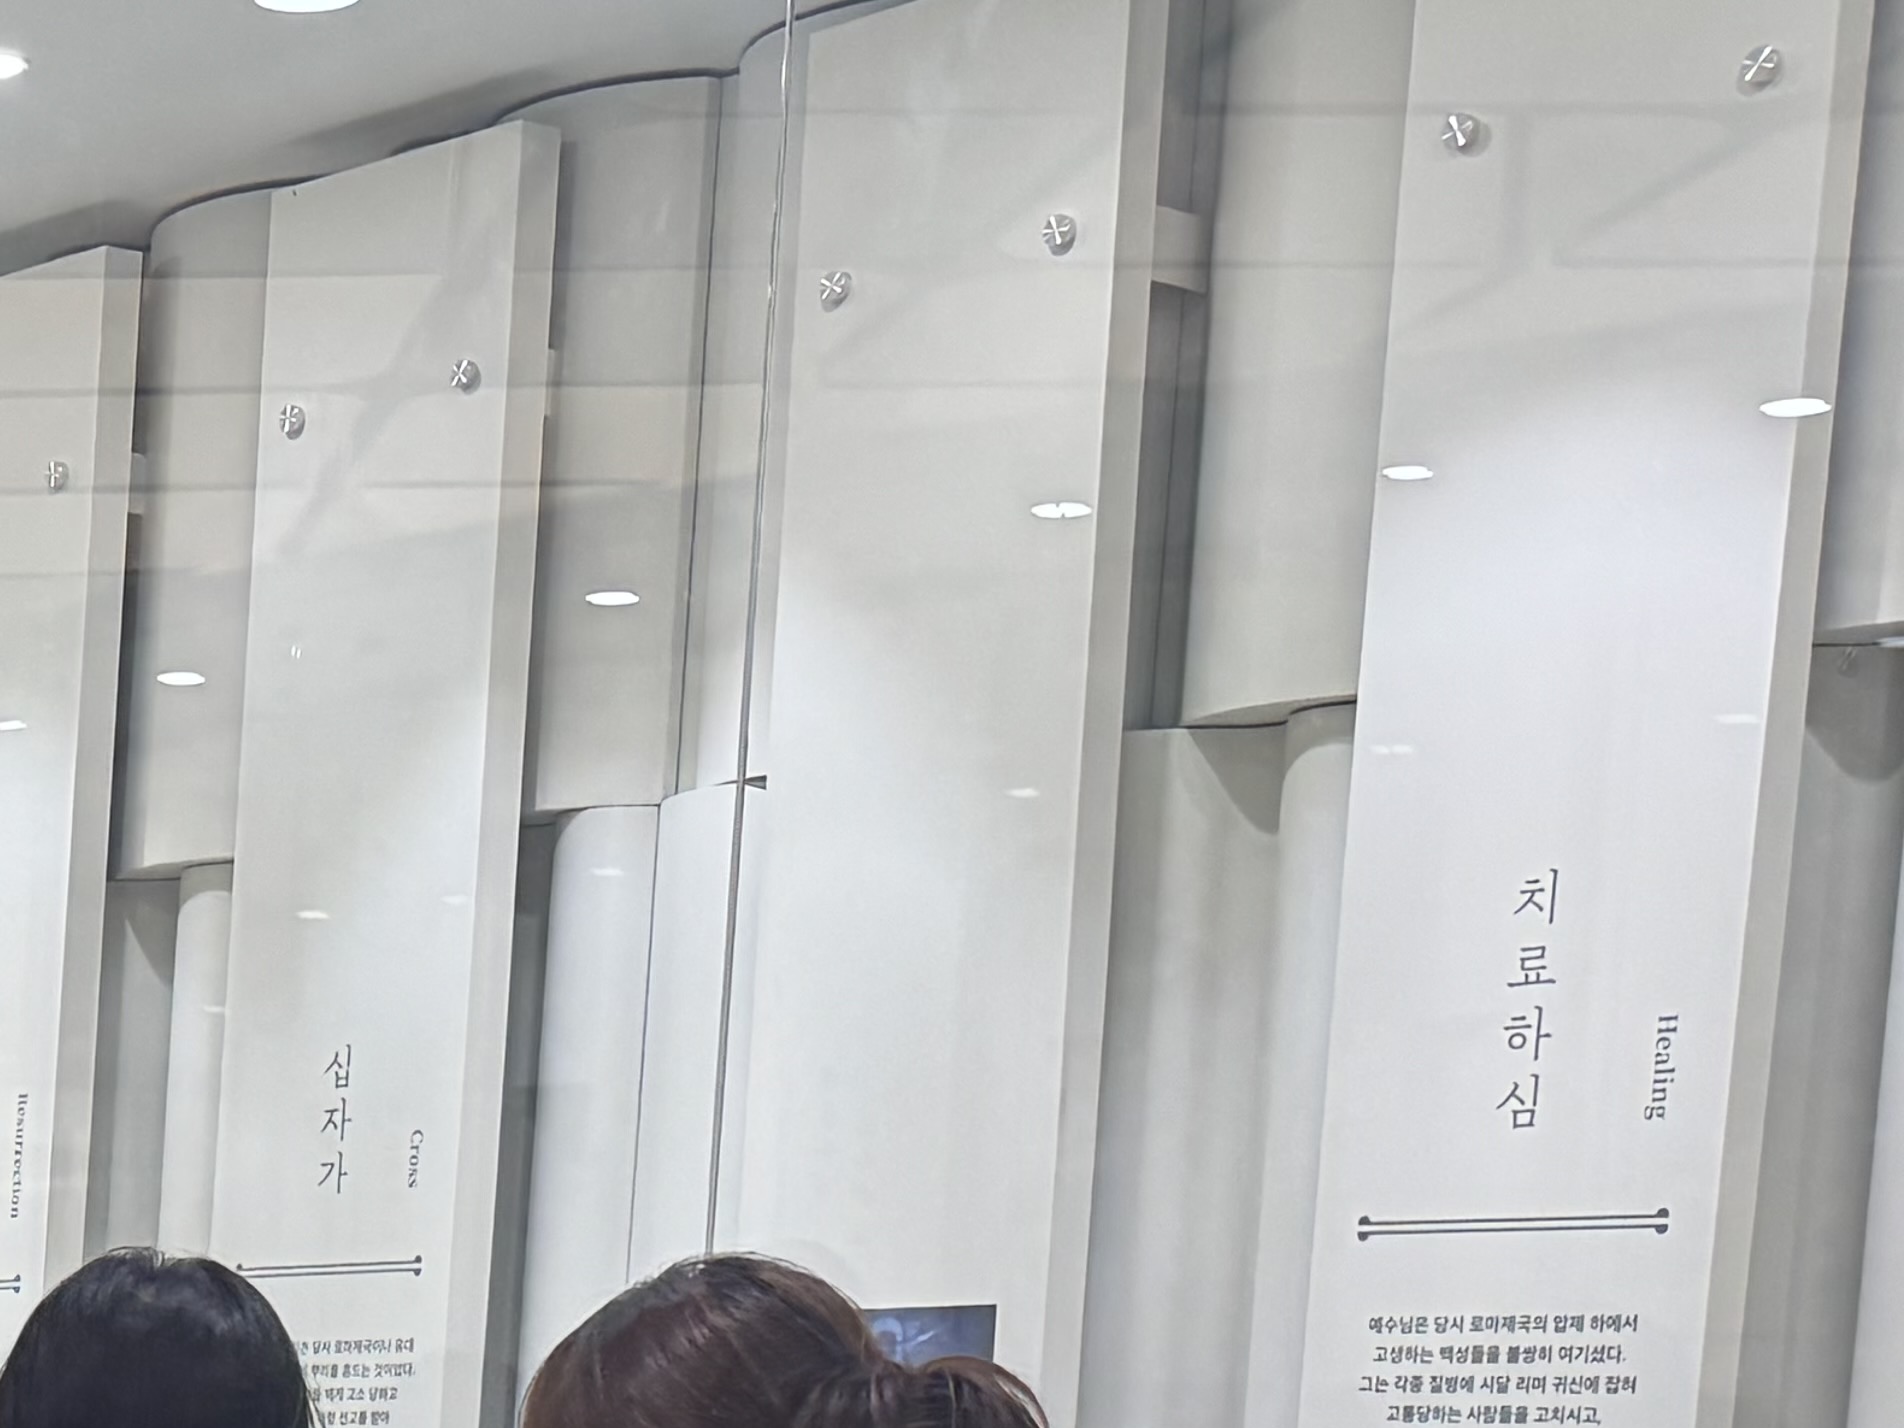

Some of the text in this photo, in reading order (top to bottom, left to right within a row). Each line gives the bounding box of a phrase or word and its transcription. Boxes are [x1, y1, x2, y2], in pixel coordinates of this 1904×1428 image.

[1495, 867, 1560, 1130] 치료하심
[1643, 1012, 1679, 1121] Healing
[317, 1043, 353, 1195] 십자가
[10, 1093, 29, 1220] Resurrection
[408, 1129, 425, 1189] Cross
[1369, 1313, 1638, 1334] 예수님은 당시 로마제국의 압제 하에서
[1373, 1345, 1434, 1364] 고생하는
[1507, 1344, 1552, 1364] 불쌍히
[1558, 1344, 1627, 1364] 여기셨다.
[1358, 1375, 1389, 1394] 그는
[1394, 1375, 1424, 1394] 각종
[1429, 1375, 1475, 1394] 질병에
[1552, 1375, 1600, 1394] 귀신에
[1604, 1375, 1637, 1394] 잡혀
[1387, 1405, 1601, 1427] 고통당하는 사람들을 고치시고,
